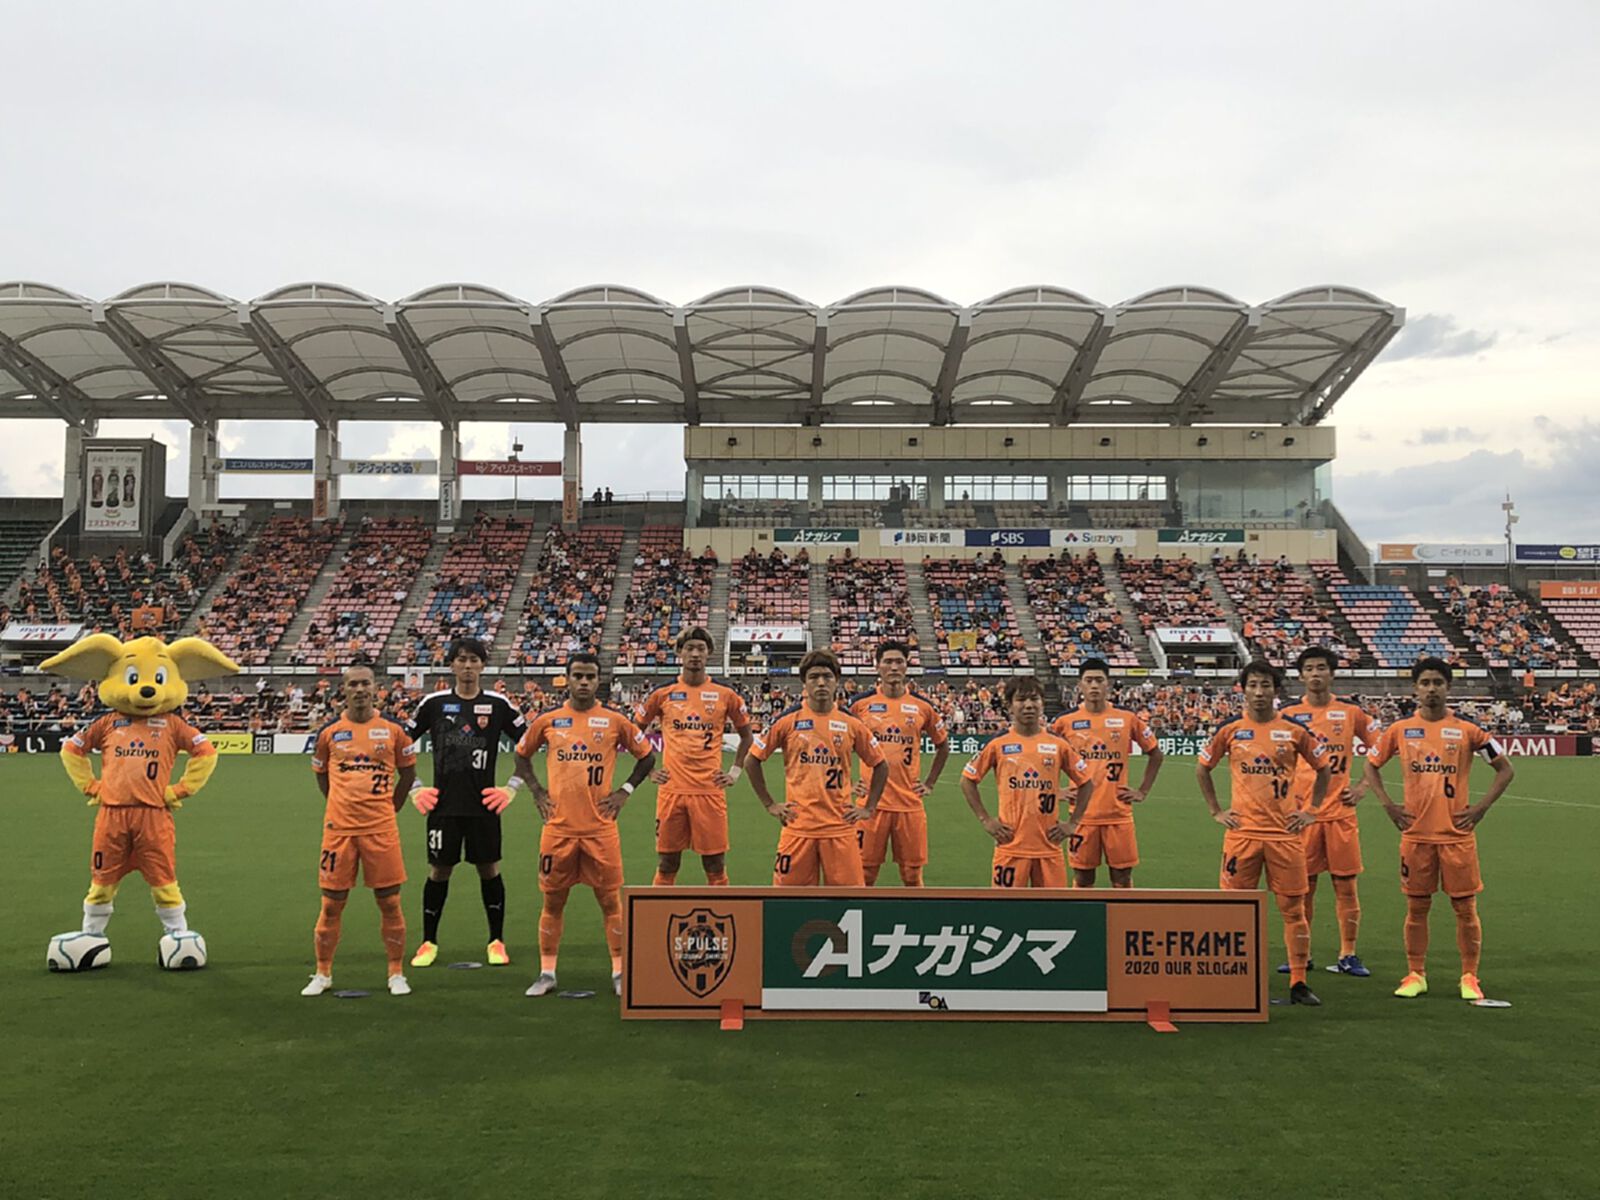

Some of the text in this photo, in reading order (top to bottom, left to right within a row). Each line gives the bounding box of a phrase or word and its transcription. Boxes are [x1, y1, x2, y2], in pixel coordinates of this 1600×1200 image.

[904, 532, 951, 544] 静岡新聞
[1001, 532, 1025, 545] SBS
[1082, 532, 1123, 545] Suzuyo
[672, 719, 714, 731] Suzuyo
[703, 732, 713, 751] 2
[873, 731, 914, 744] Suzuyo
[115, 746, 159, 758] Suzuyo
[472, 749, 488, 770] 31
[557, 750, 603, 763] Suzuyo
[903, 747, 913, 766] 3
[1079, 749, 1121, 761] Suzuyo
[146, 761, 158, 781] 0
[587, 766, 604, 786] 10
[1106, 763, 1123, 782] 37
[1411, 761, 1457, 774] Suzuyo
[371, 773, 390, 795] 21
[1008, 776, 1053, 791] Suzuyo
[1443, 776, 1455, 798] 6
[1038, 793, 1056, 814] 30
[428, 829, 443, 850] 31
[94, 851, 103, 870] 0
[320, 850, 337, 873] 21
[994, 865, 1015, 887] 30
[674, 937, 729, 951] S-PULSE
[1125, 930, 1248, 957] RE-FRAME
[1125, 961, 1248, 975] 2020 OUR SLOGAN
